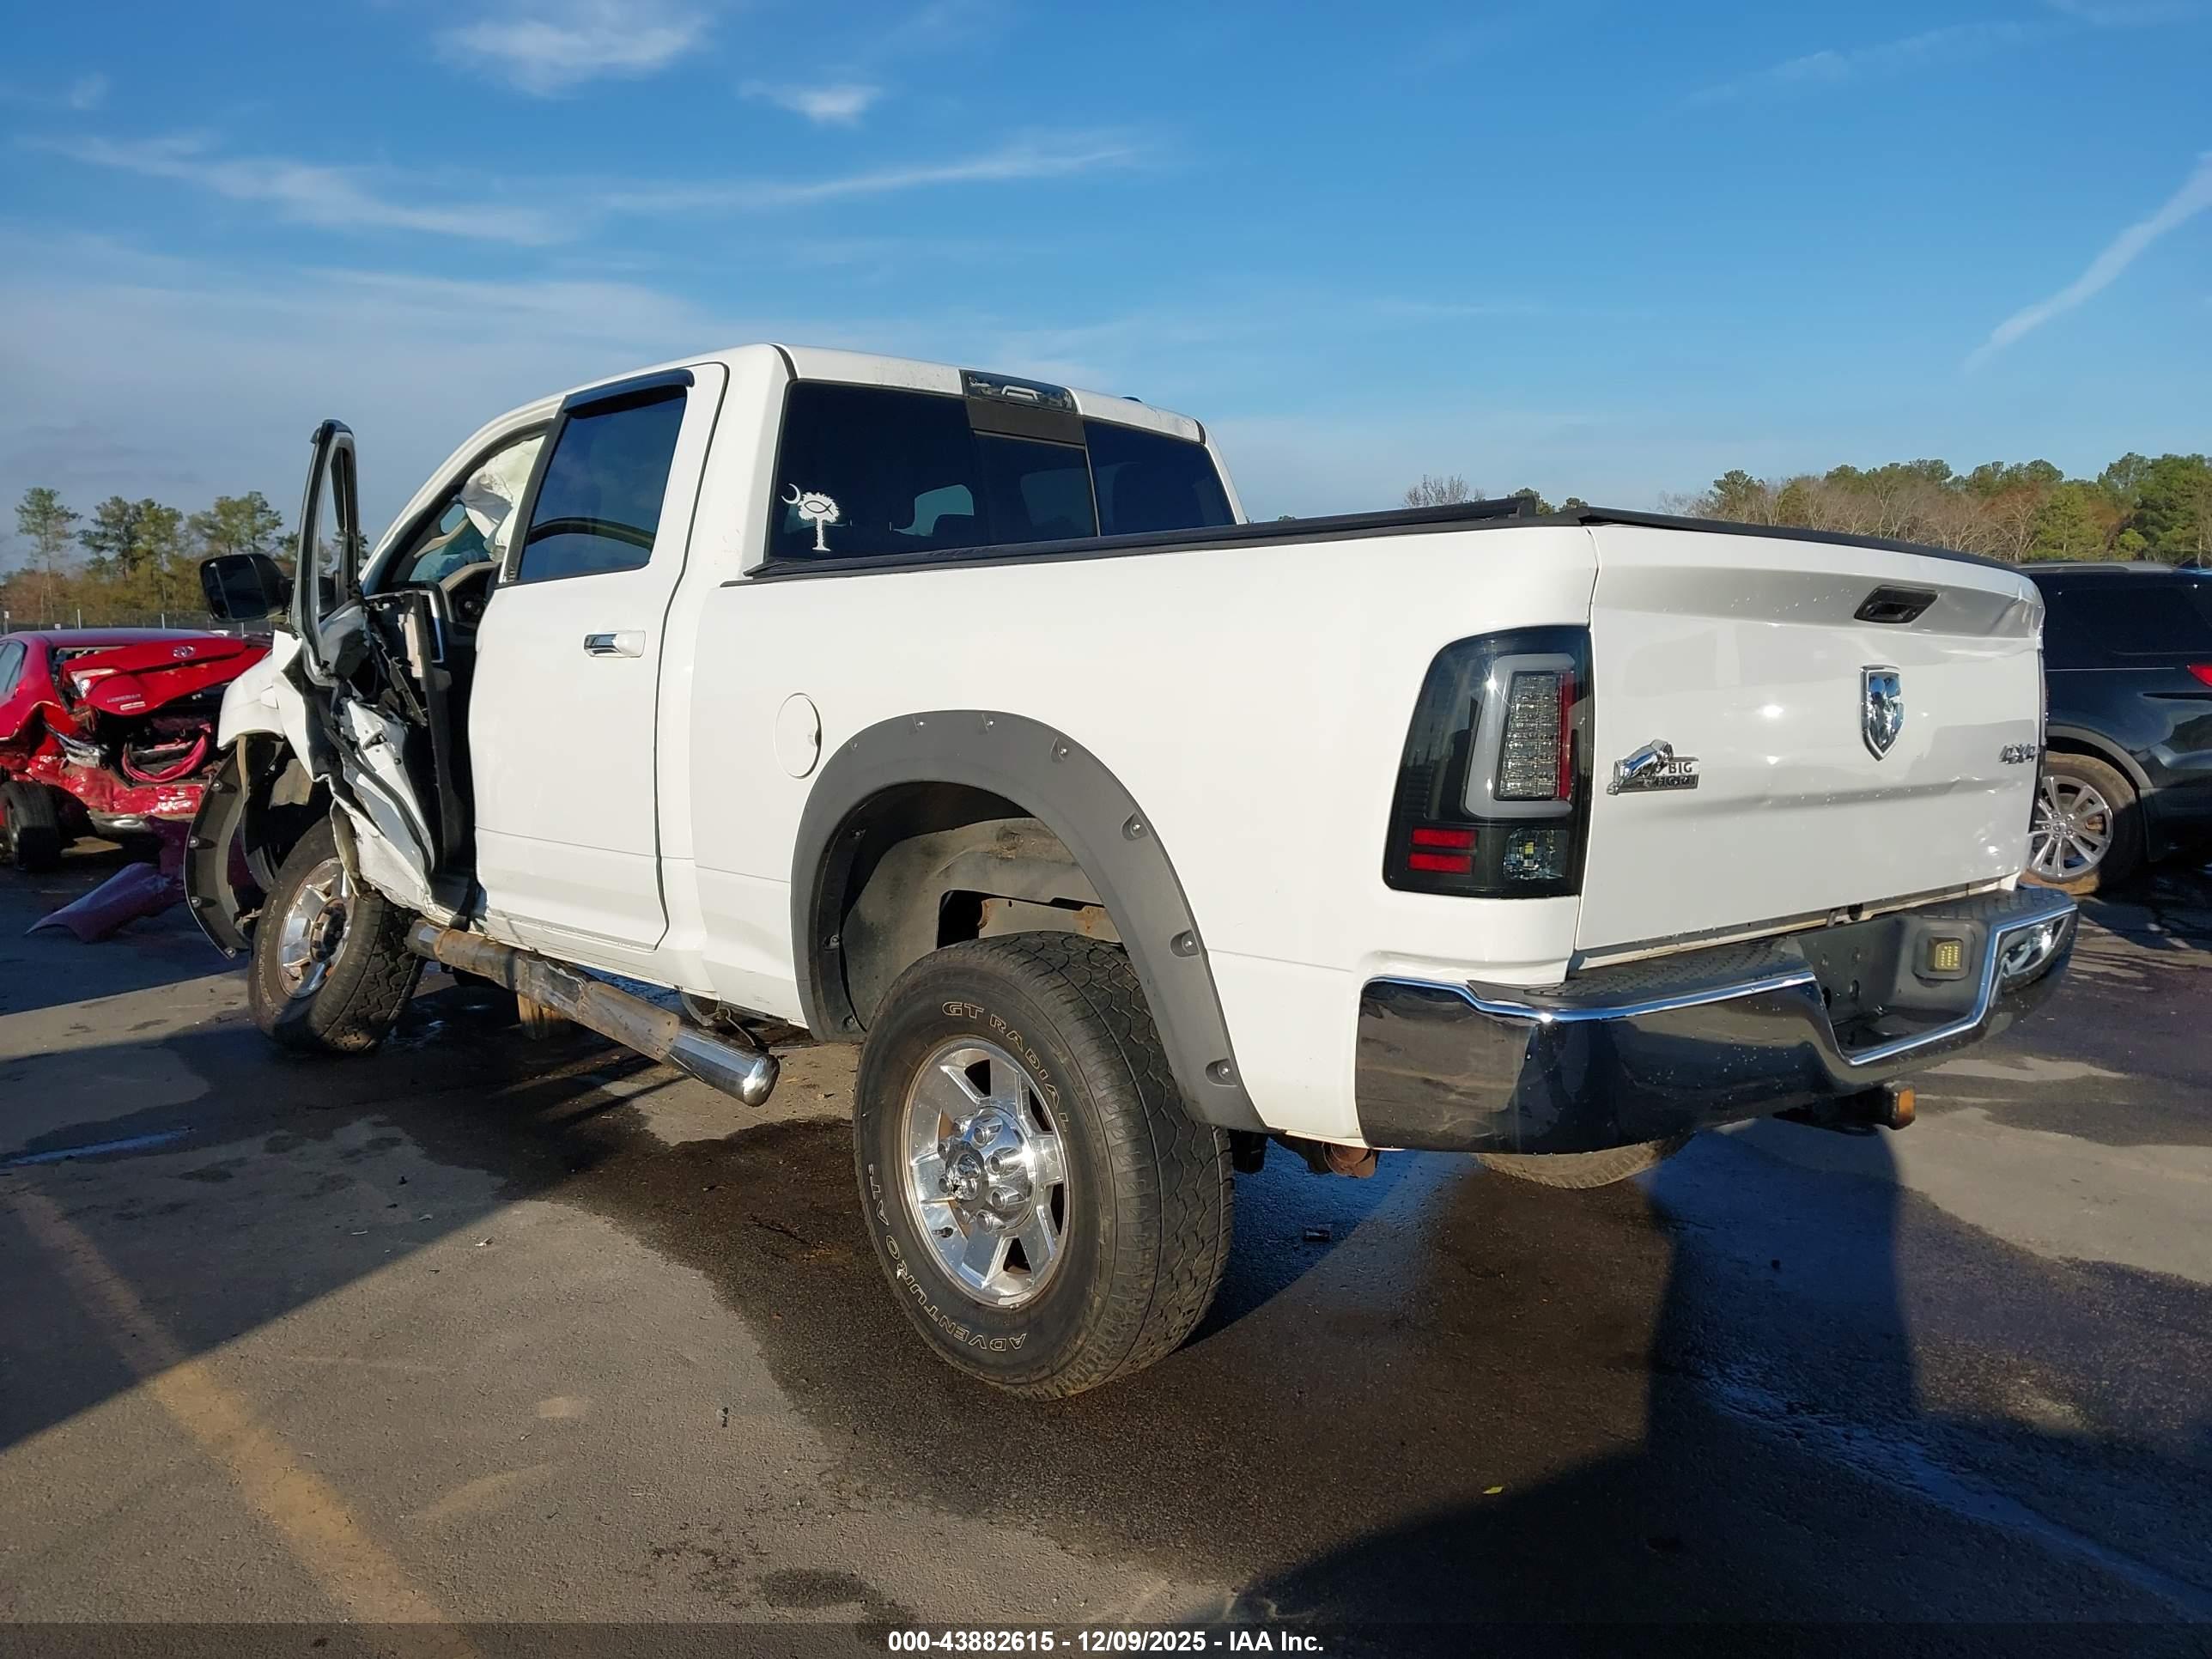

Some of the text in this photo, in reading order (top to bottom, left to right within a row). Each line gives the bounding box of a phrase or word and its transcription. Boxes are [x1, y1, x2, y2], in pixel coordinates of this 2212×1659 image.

[1668, 762, 1693, 774] BIG
[941, 1000, 1071, 1133] GT RADIAL
[885, 1234, 1027, 1352] ADVENTURO
